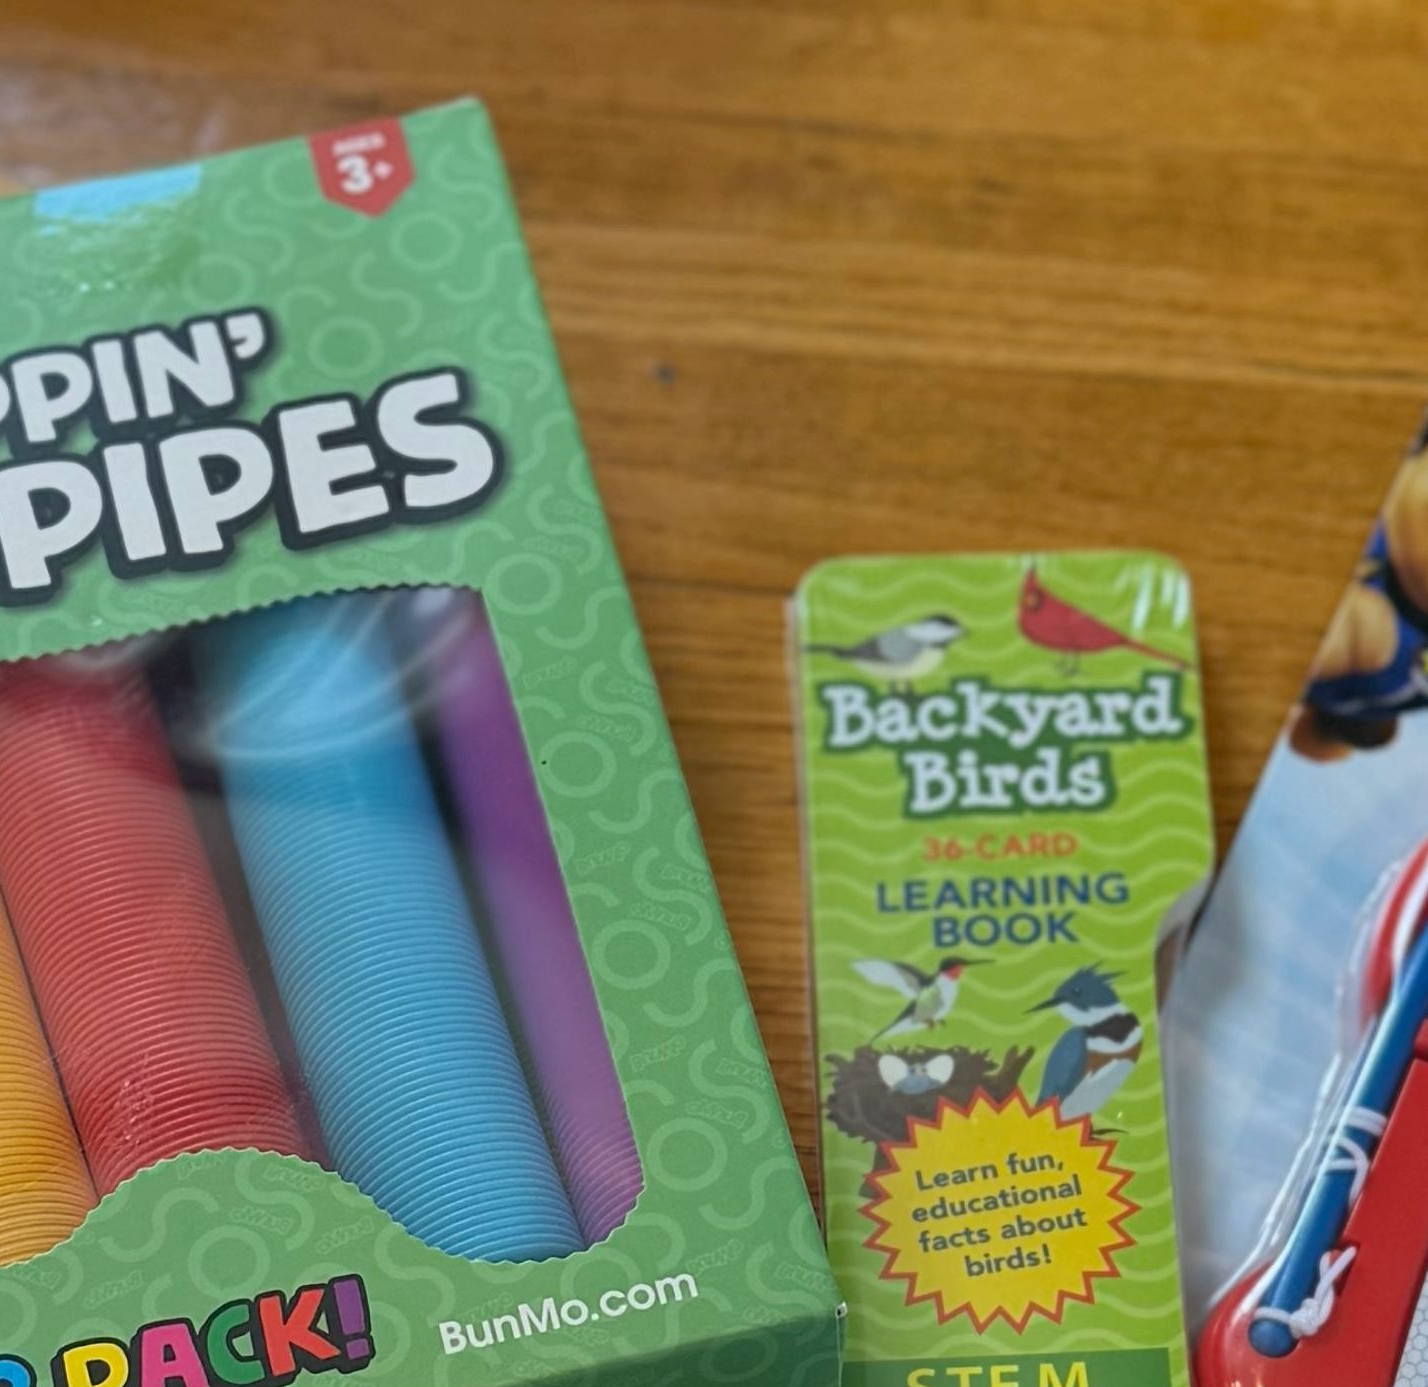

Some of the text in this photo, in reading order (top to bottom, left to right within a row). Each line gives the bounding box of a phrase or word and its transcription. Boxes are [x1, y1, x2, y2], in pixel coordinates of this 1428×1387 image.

[823, 677, 1185, 749] Backyard
[905, 748, 1108, 813] Birds
[877, 872, 1130, 913] LEARNING
[932, 912, 1079, 949] BOOK
[916, 1151, 1065, 1193] Learn fun,
[911, 1175, 1082, 1224] educational
[919, 1208, 1088, 1254] facts about
[965, 1243, 1053, 1278] birds!
[437, 1271, 700, 1357] BunMo.com
